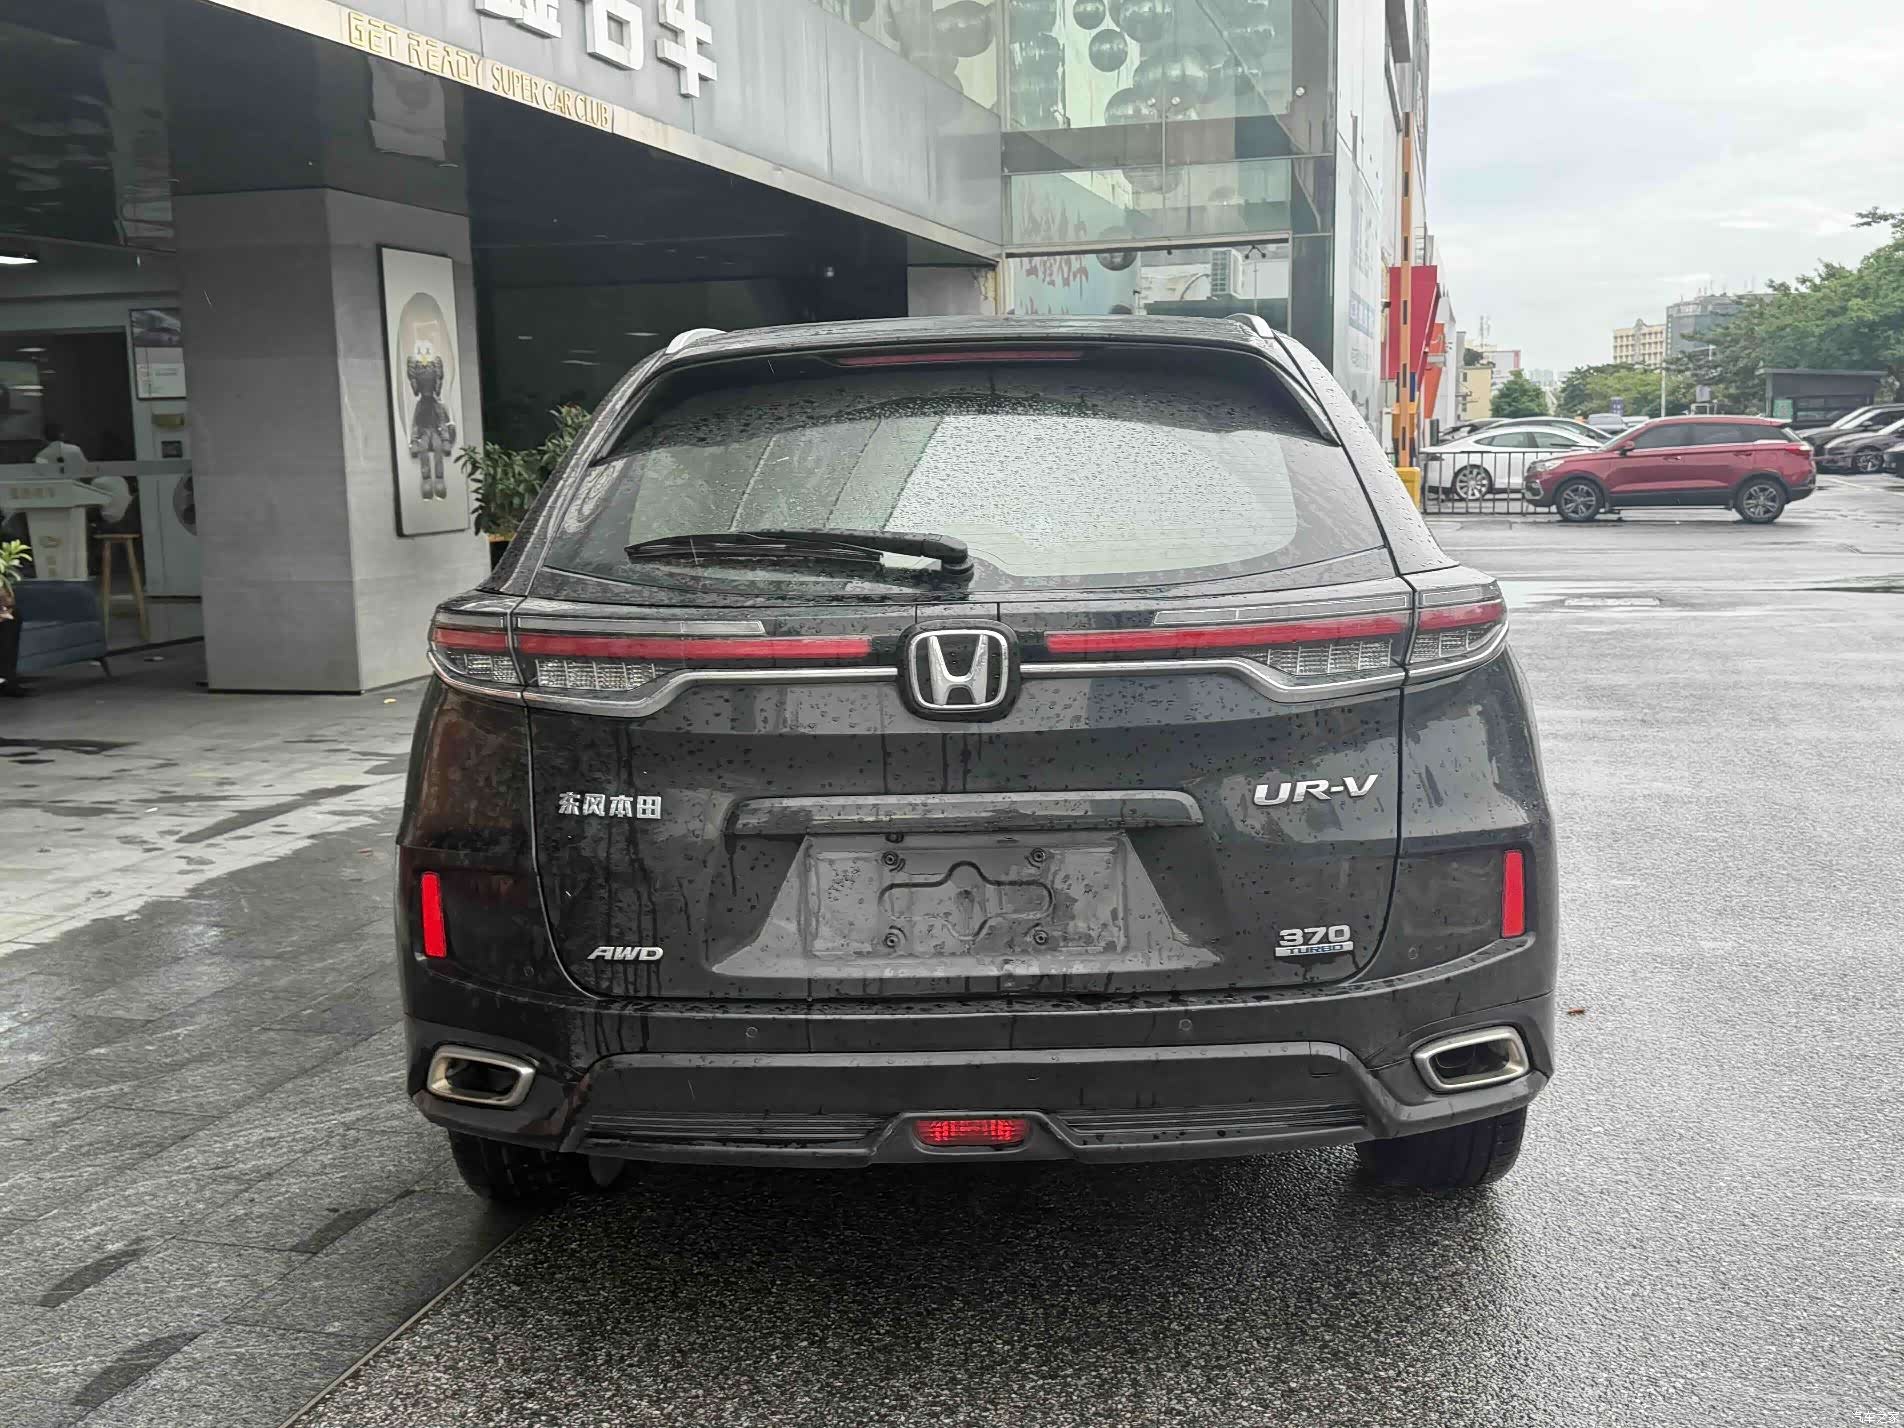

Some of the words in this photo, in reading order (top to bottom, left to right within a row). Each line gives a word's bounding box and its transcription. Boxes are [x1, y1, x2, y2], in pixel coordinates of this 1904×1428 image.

[348, 11, 399, 57] GET
[406, 32, 482, 87] READY
[491, 63, 540, 106] SUPER
[542, 82, 572, 117] CAR
[574, 94, 609, 128] CLUB
[1253, 774, 1379, 806] UR-V
[558, 791, 662, 819] 东风本田
[1279, 924, 1351, 947] 370
[586, 946, 664, 961] AWD
[1286, 944, 1344, 955] TURBO
